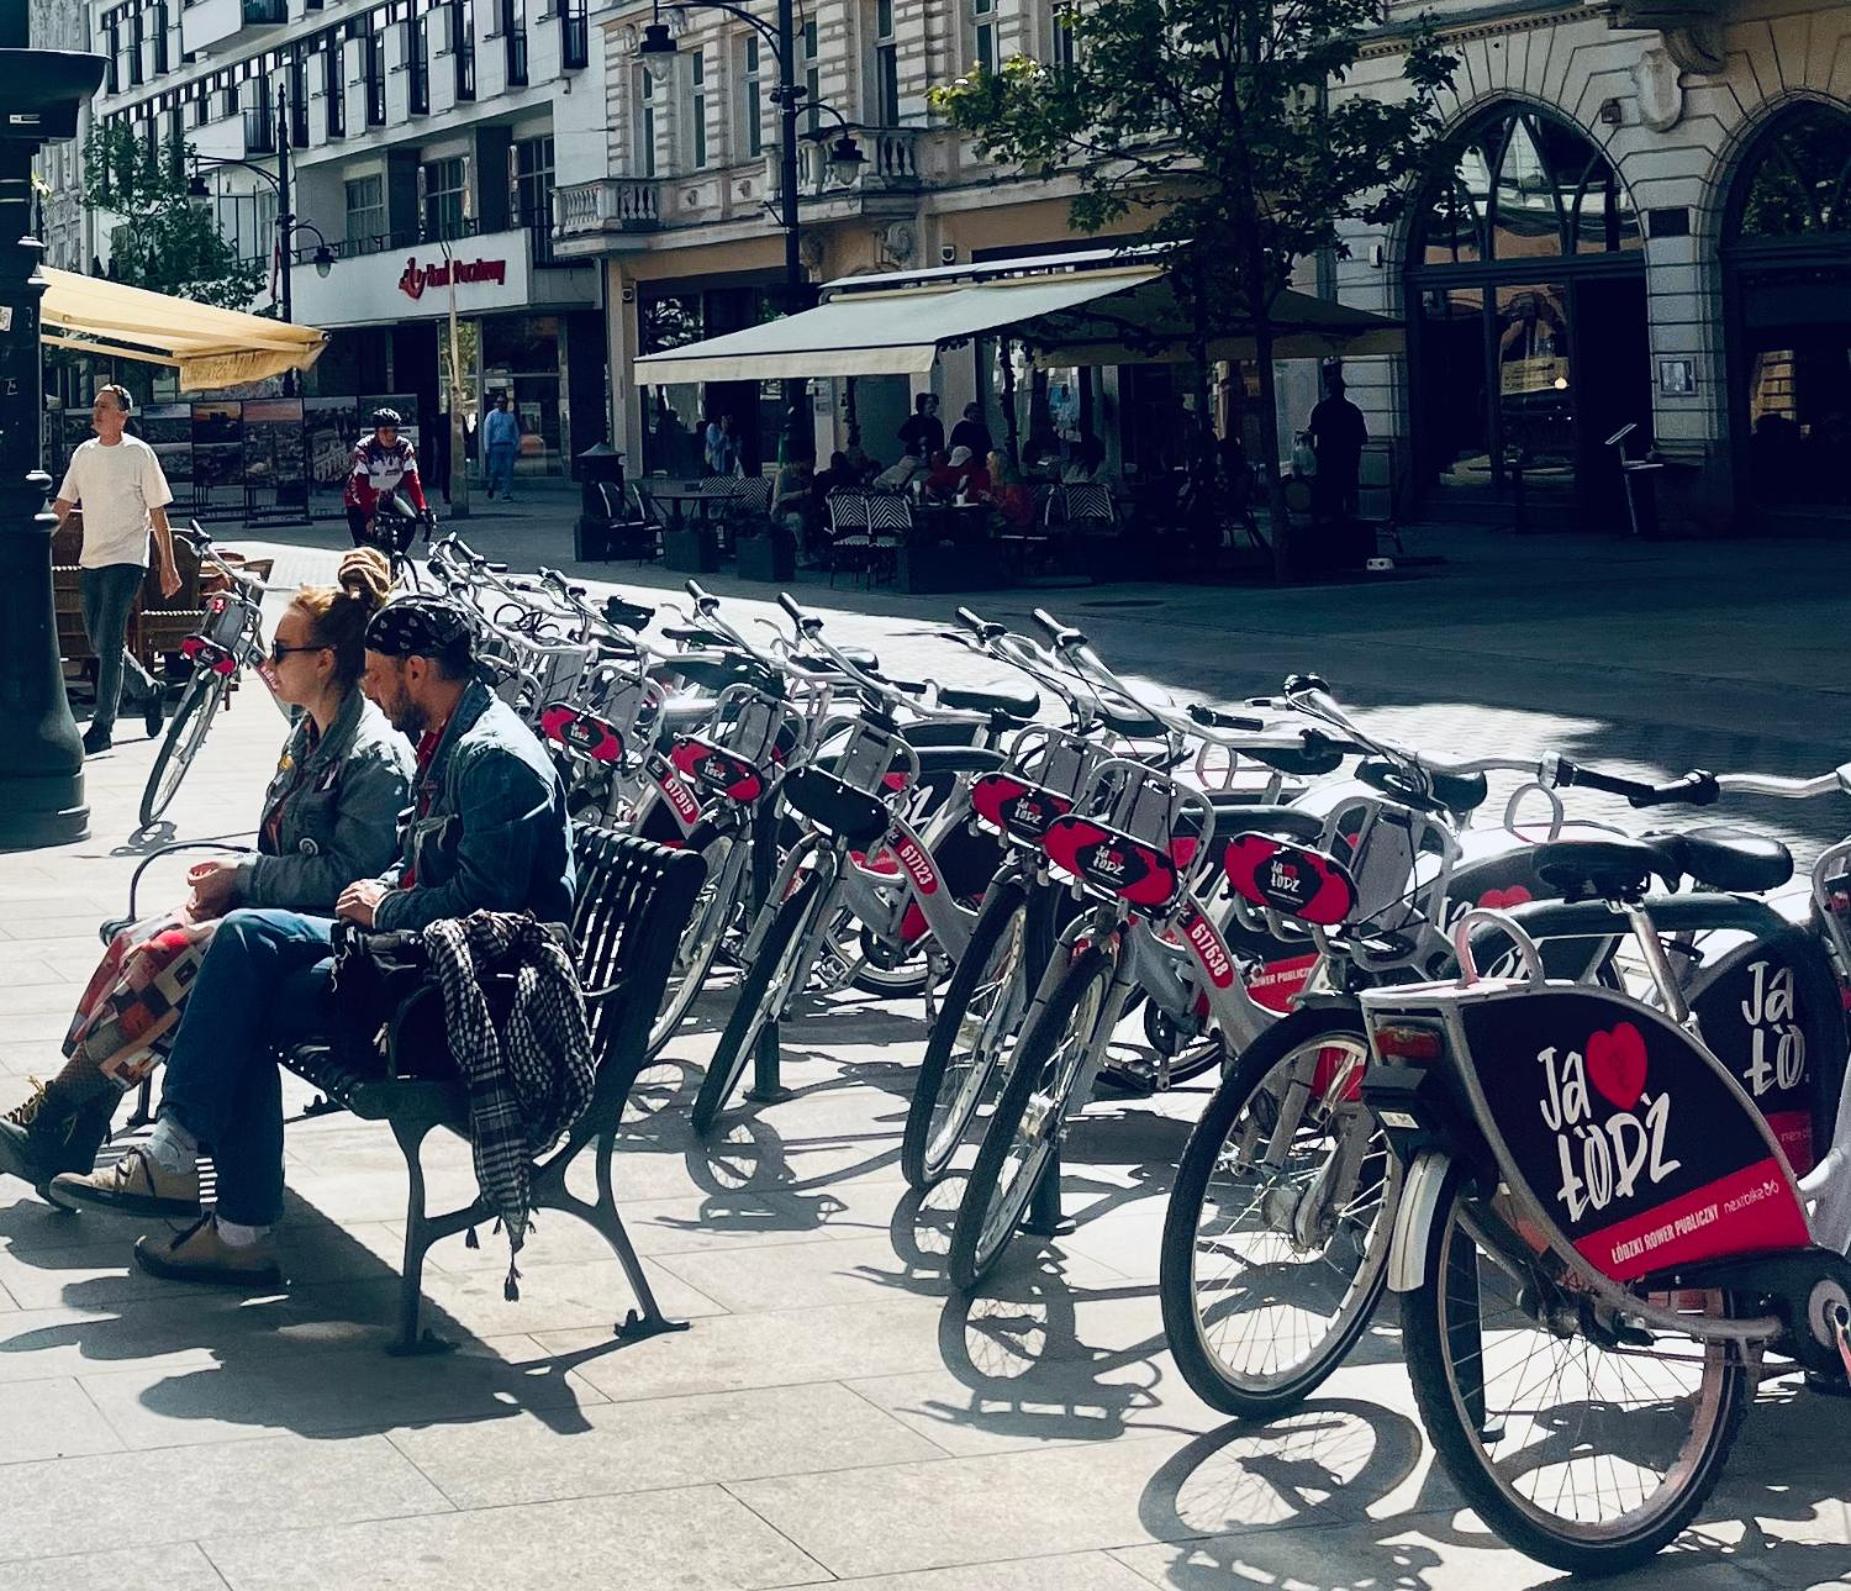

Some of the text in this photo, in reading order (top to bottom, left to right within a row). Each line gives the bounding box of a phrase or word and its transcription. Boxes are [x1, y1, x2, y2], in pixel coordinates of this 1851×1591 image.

[664, 777, 694, 815] 617919
[900, 844, 933, 885] 617123
[1191, 923, 1229, 977] 617638
[1644, 1223, 1675, 1251] ROWER
[1674, 1203, 1720, 1237] PUBLICZNY
